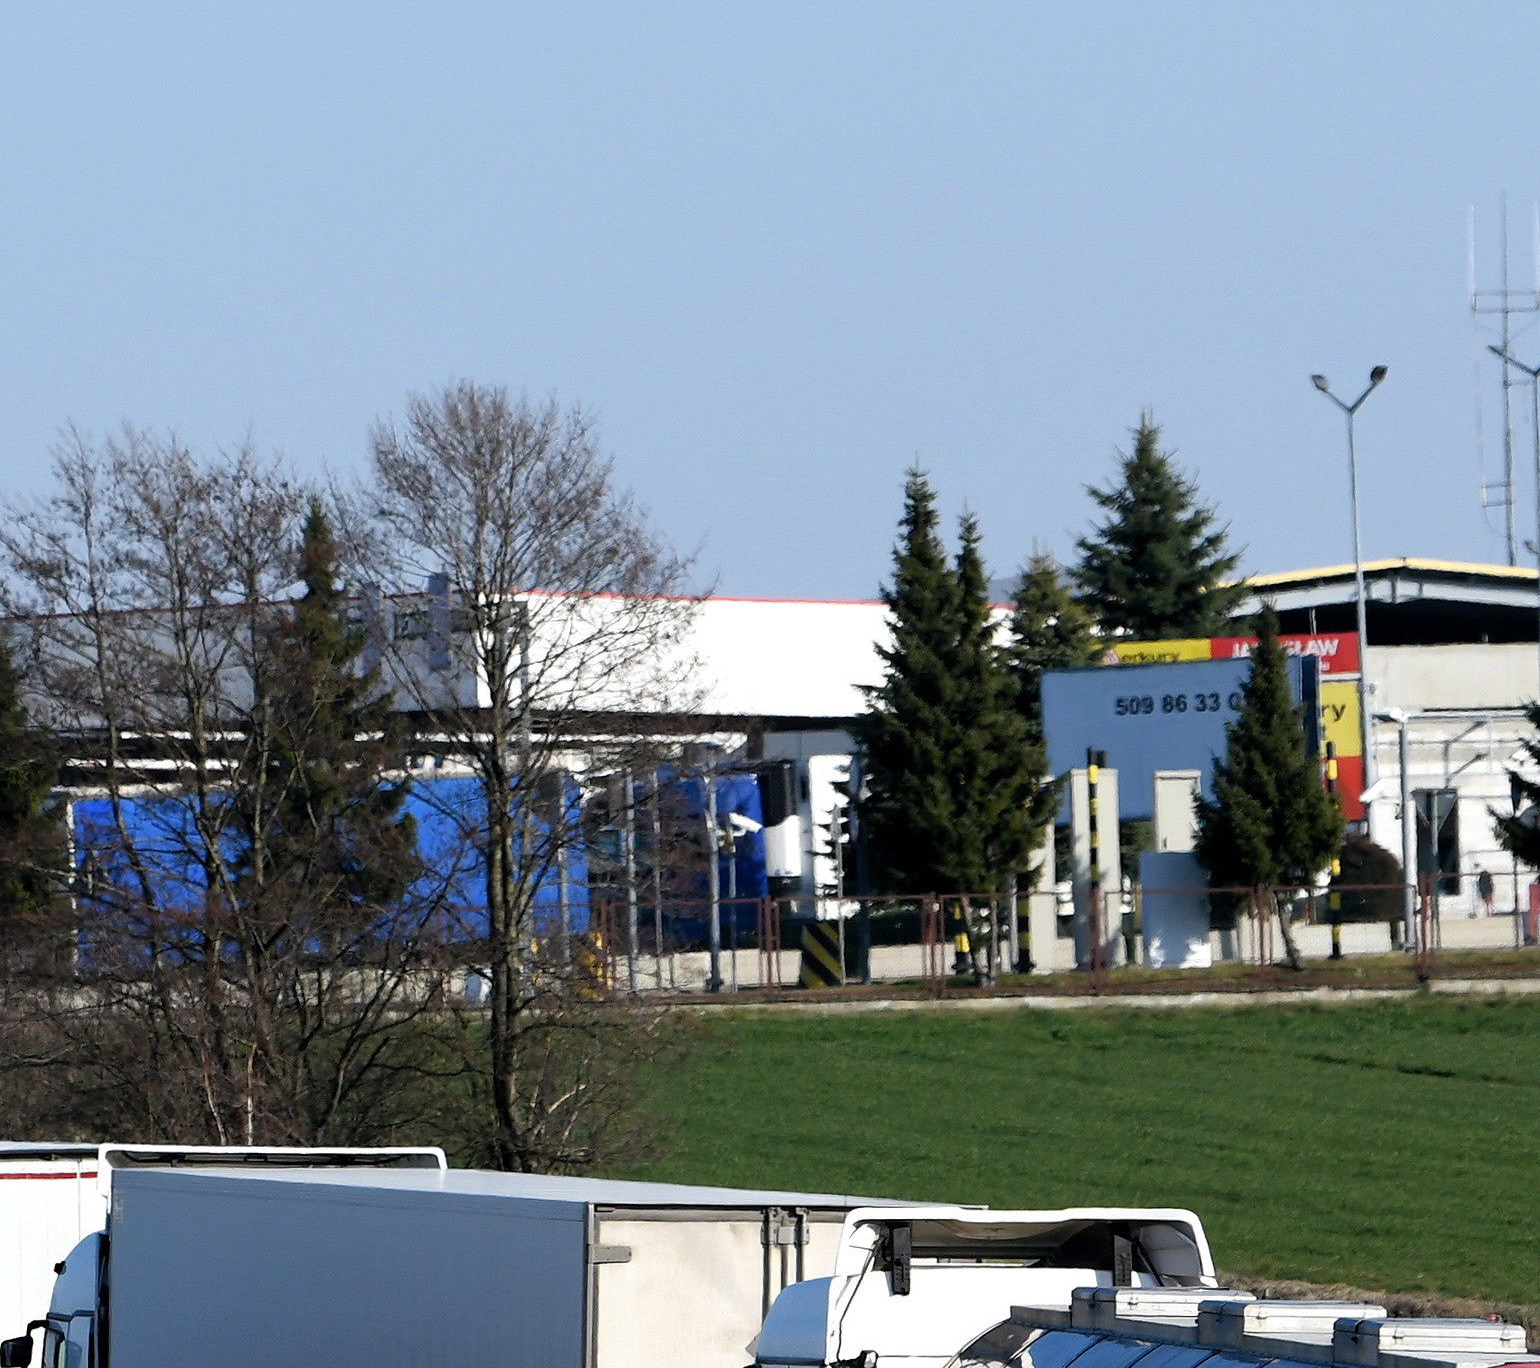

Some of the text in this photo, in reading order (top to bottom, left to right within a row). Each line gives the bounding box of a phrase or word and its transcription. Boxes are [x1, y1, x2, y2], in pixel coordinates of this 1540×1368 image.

[1115, 696, 1154, 716] 509
[1162, 694, 1188, 715] 86
[1194, 692, 1221, 712] 33
